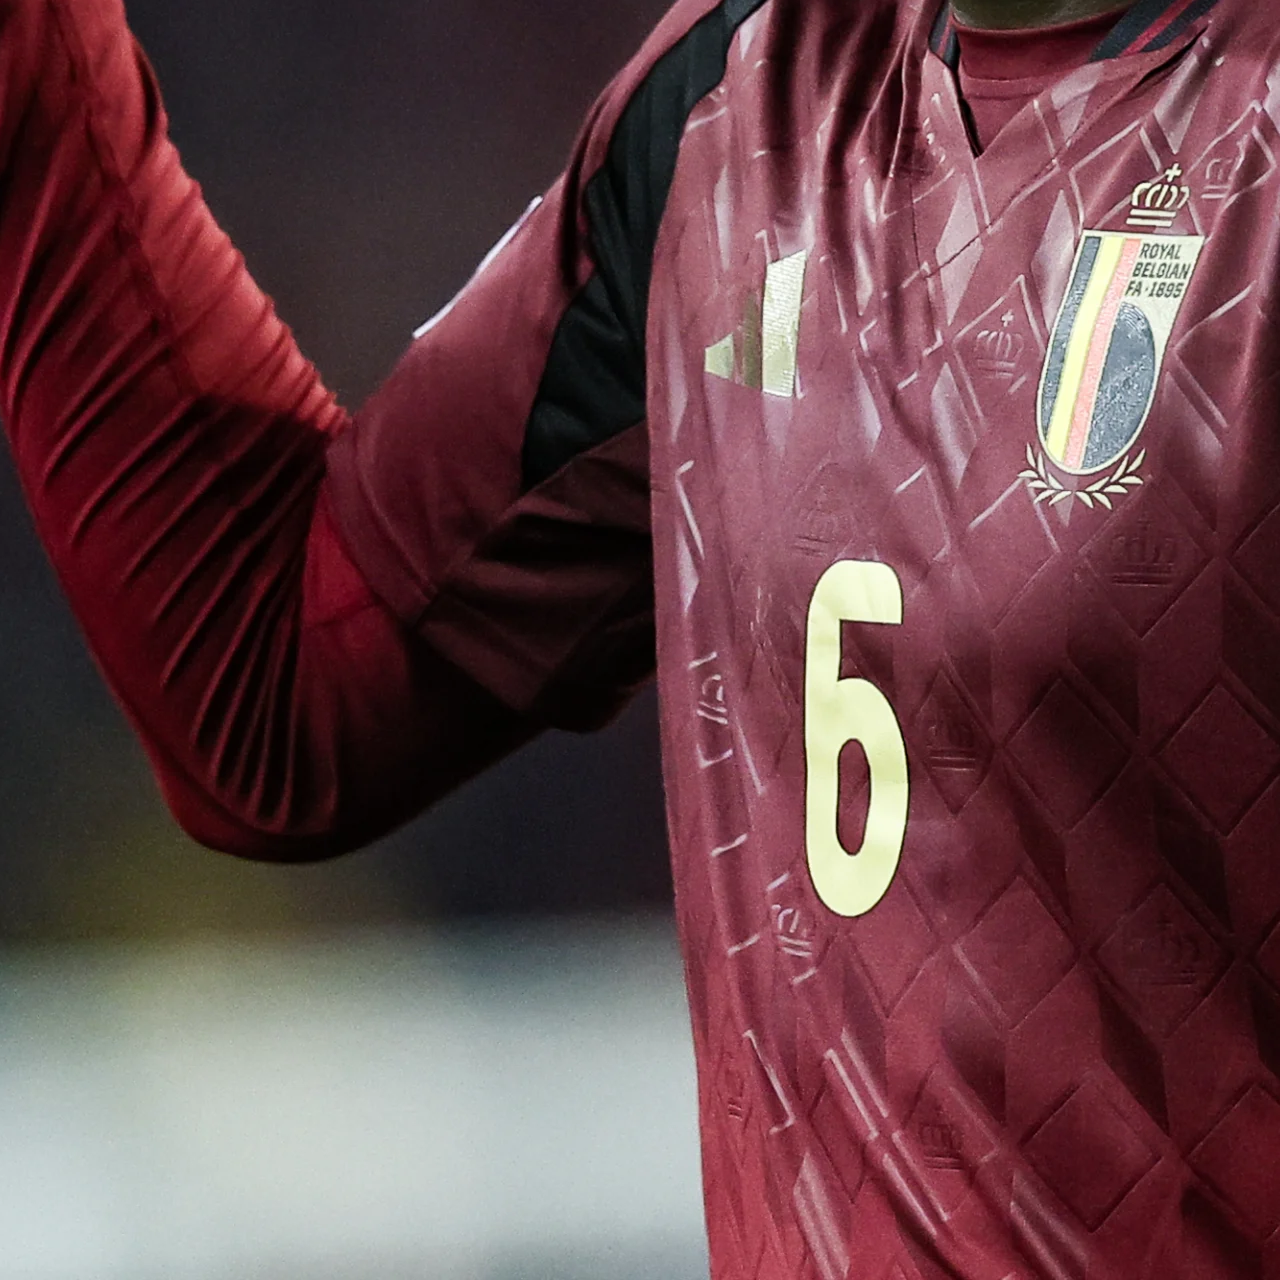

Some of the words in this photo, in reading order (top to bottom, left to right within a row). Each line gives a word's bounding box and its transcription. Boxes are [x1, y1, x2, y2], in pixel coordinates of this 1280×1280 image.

[1139, 243, 1181, 260] ROYAL
[1132, 262, 1191, 280] BELGIAN
[805, 560, 910, 917] 6
